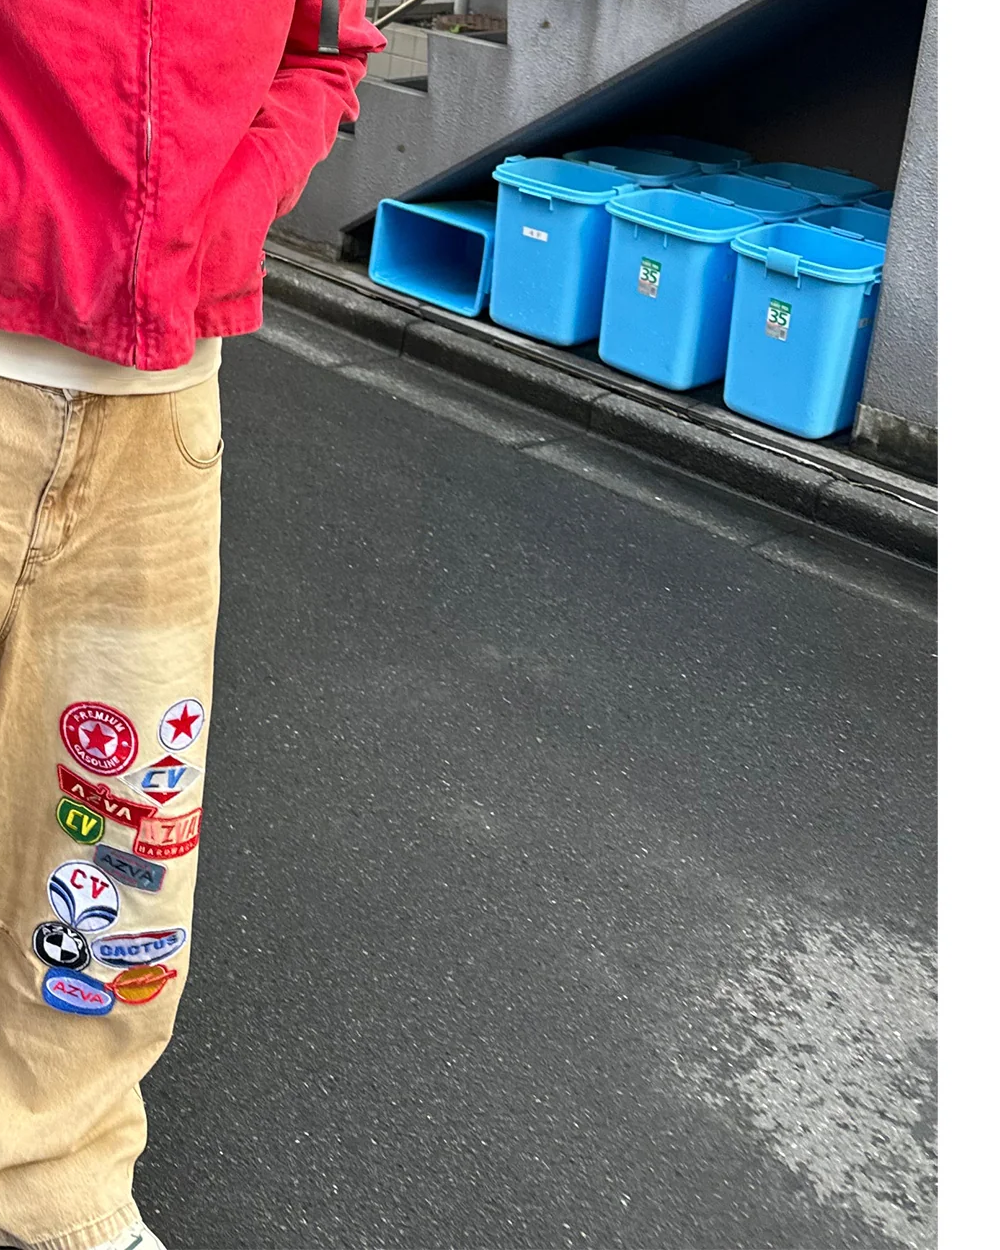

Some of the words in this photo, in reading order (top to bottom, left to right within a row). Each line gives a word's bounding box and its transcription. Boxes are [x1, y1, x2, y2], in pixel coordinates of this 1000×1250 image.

[640, 268, 657, 284] 35
[768, 309, 788, 326] 35
[73, 710, 126, 732] PREMIUM
[74, 744, 120, 769] GASOLINE
[141, 767, 187, 789] CV
[66, 809, 97, 837] CV
[101, 854, 154, 883] AZVA
[70, 869, 109, 899] CV
[100, 935, 178, 956] CACTUS
[53, 981, 104, 1005] AZVA
